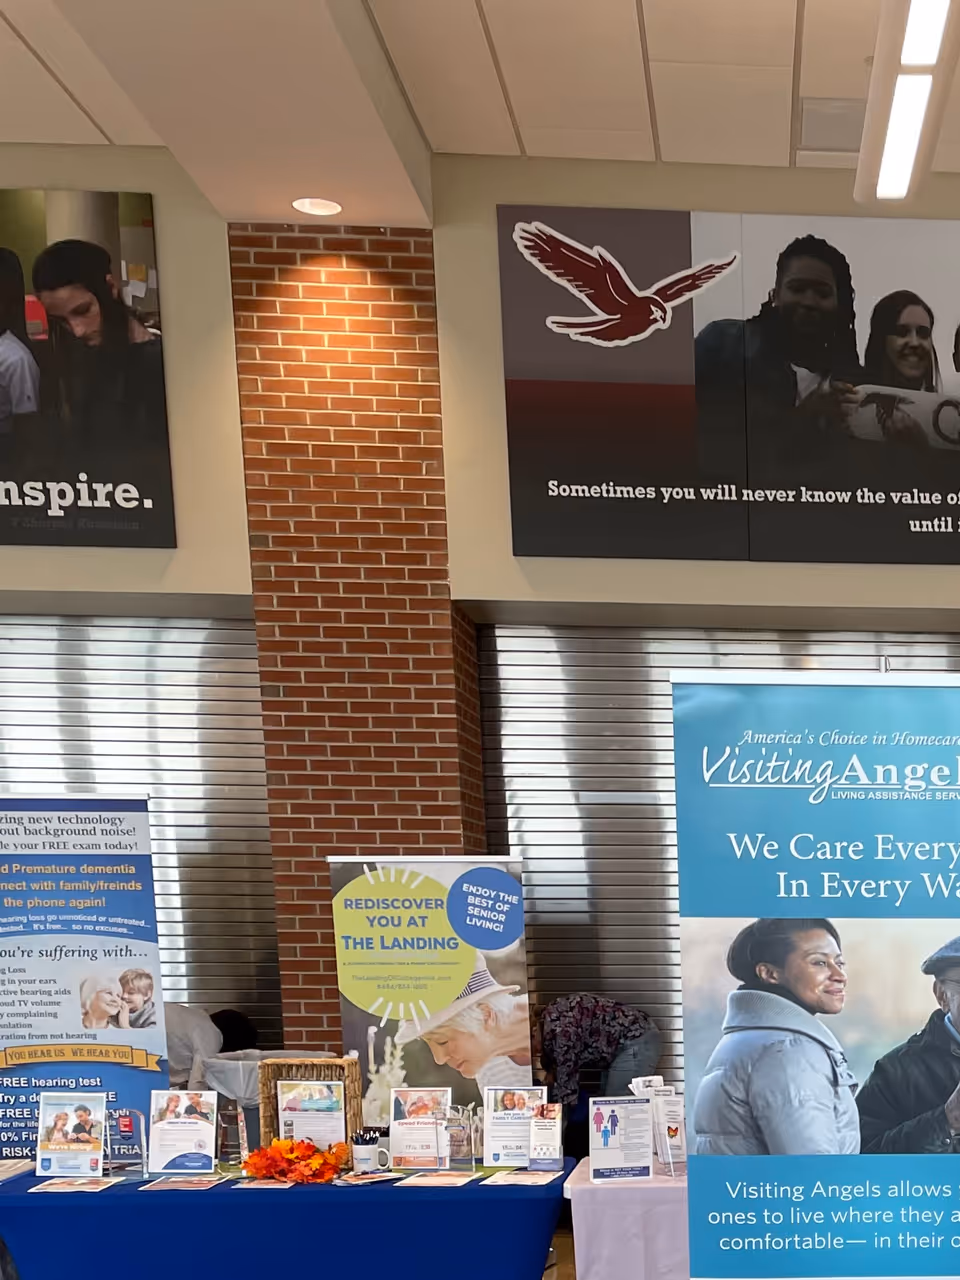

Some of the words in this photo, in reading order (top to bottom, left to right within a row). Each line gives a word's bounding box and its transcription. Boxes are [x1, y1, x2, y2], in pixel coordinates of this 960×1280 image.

[0, 472, 153, 517] nspire.
[548, 479, 656, 501] Sometimes
[660, 484, 695, 503] you
[699, 482, 738, 502] will
[742, 487, 796, 504] never
[799, 486, 851, 506] know
[855, 487, 886, 505] the
[890, 487, 942, 506] value
[909, 516, 953, 534] until
[738, 729, 814, 747] America's
[819, 731, 869, 747] Choice
[872, 731, 887, 747] in
[832, 791, 865, 800] LIVING
[868, 791, 932, 800] ASSISTANCE
[57, 814, 125, 827] technology
[24, 826, 96, 838] background
[100, 827, 136, 837] noise!
[13, 842, 39, 852] your
[42, 841, 70, 850] FREE
[72, 842, 101, 850] exam
[104, 841, 138, 852] today!
[727, 832, 779, 861] We
[789, 833, 865, 861] Care
[12, 864, 76, 874] Premature
[80, 864, 136, 874] dementia
[30, 881, 56, 890] with
[462, 883, 497, 898] ENJOY
[498, 892, 519, 904] THE
[776, 872, 809, 899] In
[820, 872, 912, 907] Every
[4, 897, 23, 907] the
[27, 898, 65, 909] phone
[69, 897, 106, 909] again!
[344, 898, 445, 910] REDISCOVER
[467, 895, 494, 908] BEST
[495, 901, 511, 912] OF
[366, 916, 401, 928] YOU
[406, 916, 428, 927] AT
[467, 906, 506, 922] SENIOR
[466, 916, 504, 933] LIVING!
[38, 945, 98, 961] suffering
[8, 1051, 26, 1061] YOU
[28, 1050, 52, 1059] HEAR
[55, 1048, 65, 1058] US
[71, 1048, 84, 1057] WE
[87, 1048, 110, 1058] HEAR
[111, 1049, 129, 1060] YOU
[31, 1077, 76, 1088] hearing
[79, 1077, 101, 1086] test
[726, 1181, 805, 1201] Visiting
[811, 1180, 881, 1200] Angels
[887, 1181, 952, 1197] allows
[708, 1211, 757, 1226] ones
[762, 1210, 783, 1225] to
[789, 1207, 824, 1224] live
[830, 1206, 894, 1223] where
[900, 1206, 944, 1226] they
[874, 1233, 891, 1248] in
[897, 1231, 945, 1248] their
